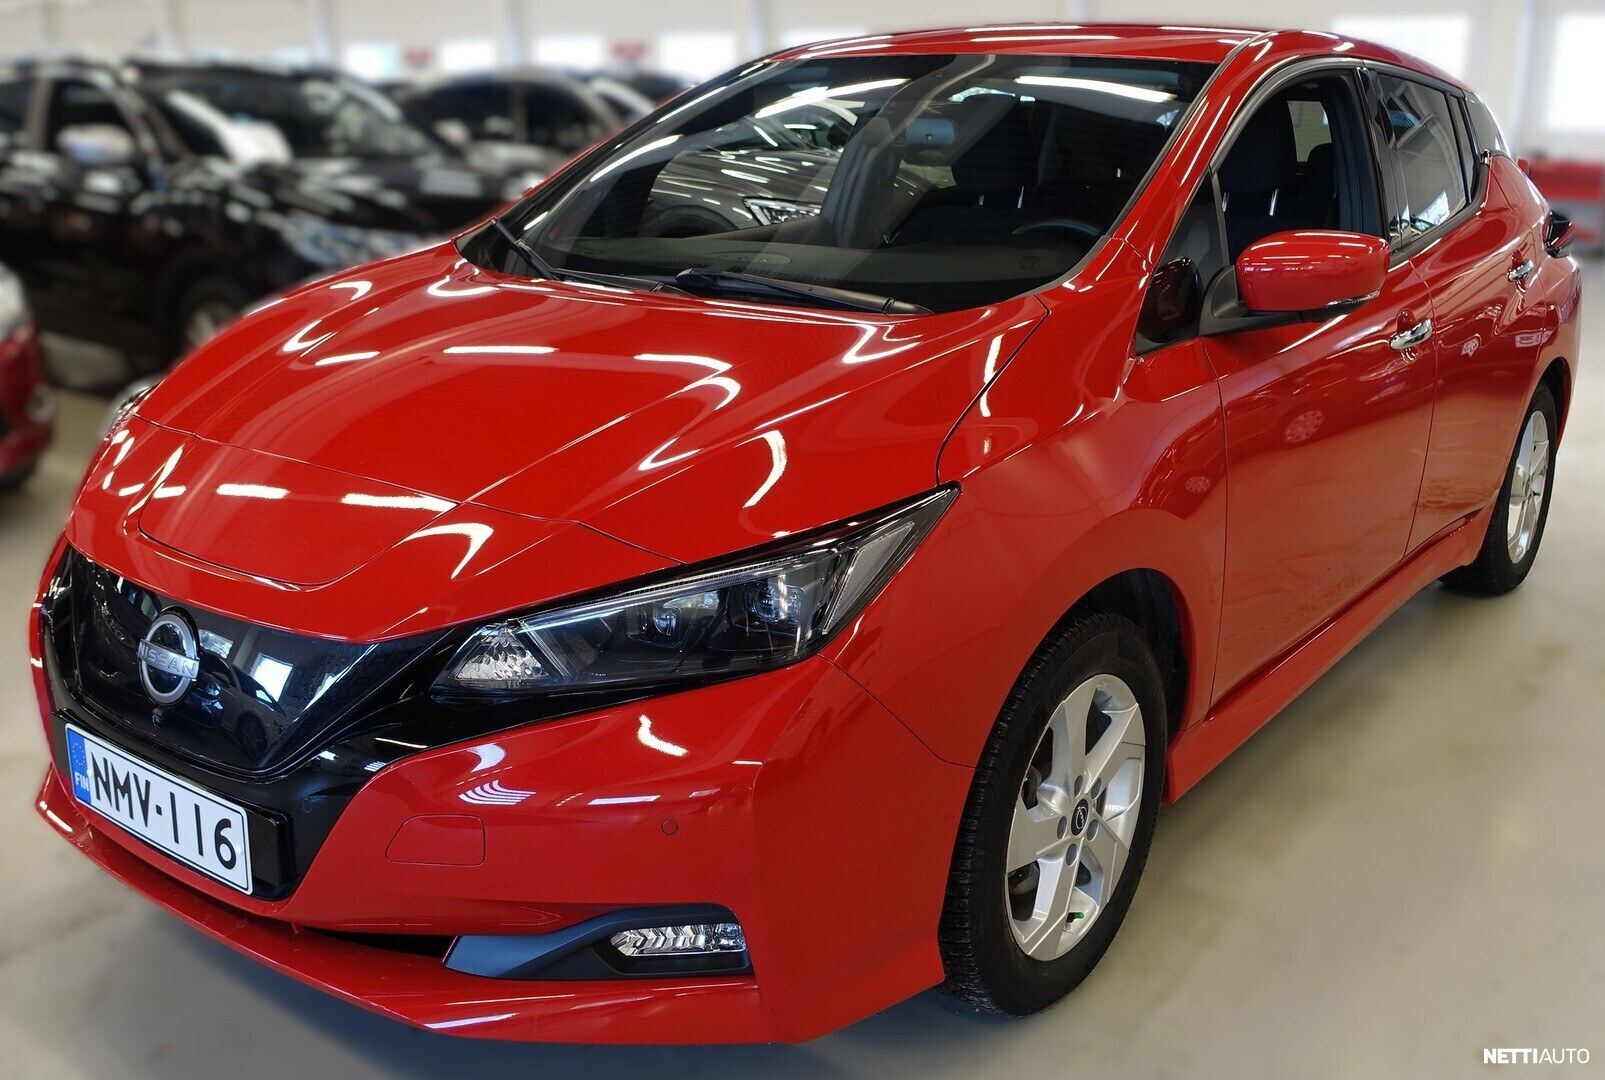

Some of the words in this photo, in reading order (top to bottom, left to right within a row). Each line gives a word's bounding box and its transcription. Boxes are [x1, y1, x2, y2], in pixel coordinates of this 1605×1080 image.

[138, 644, 196, 676] NISSAN
[74, 772, 89, 791] FIN
[91, 752, 237, 870] NMV-116
